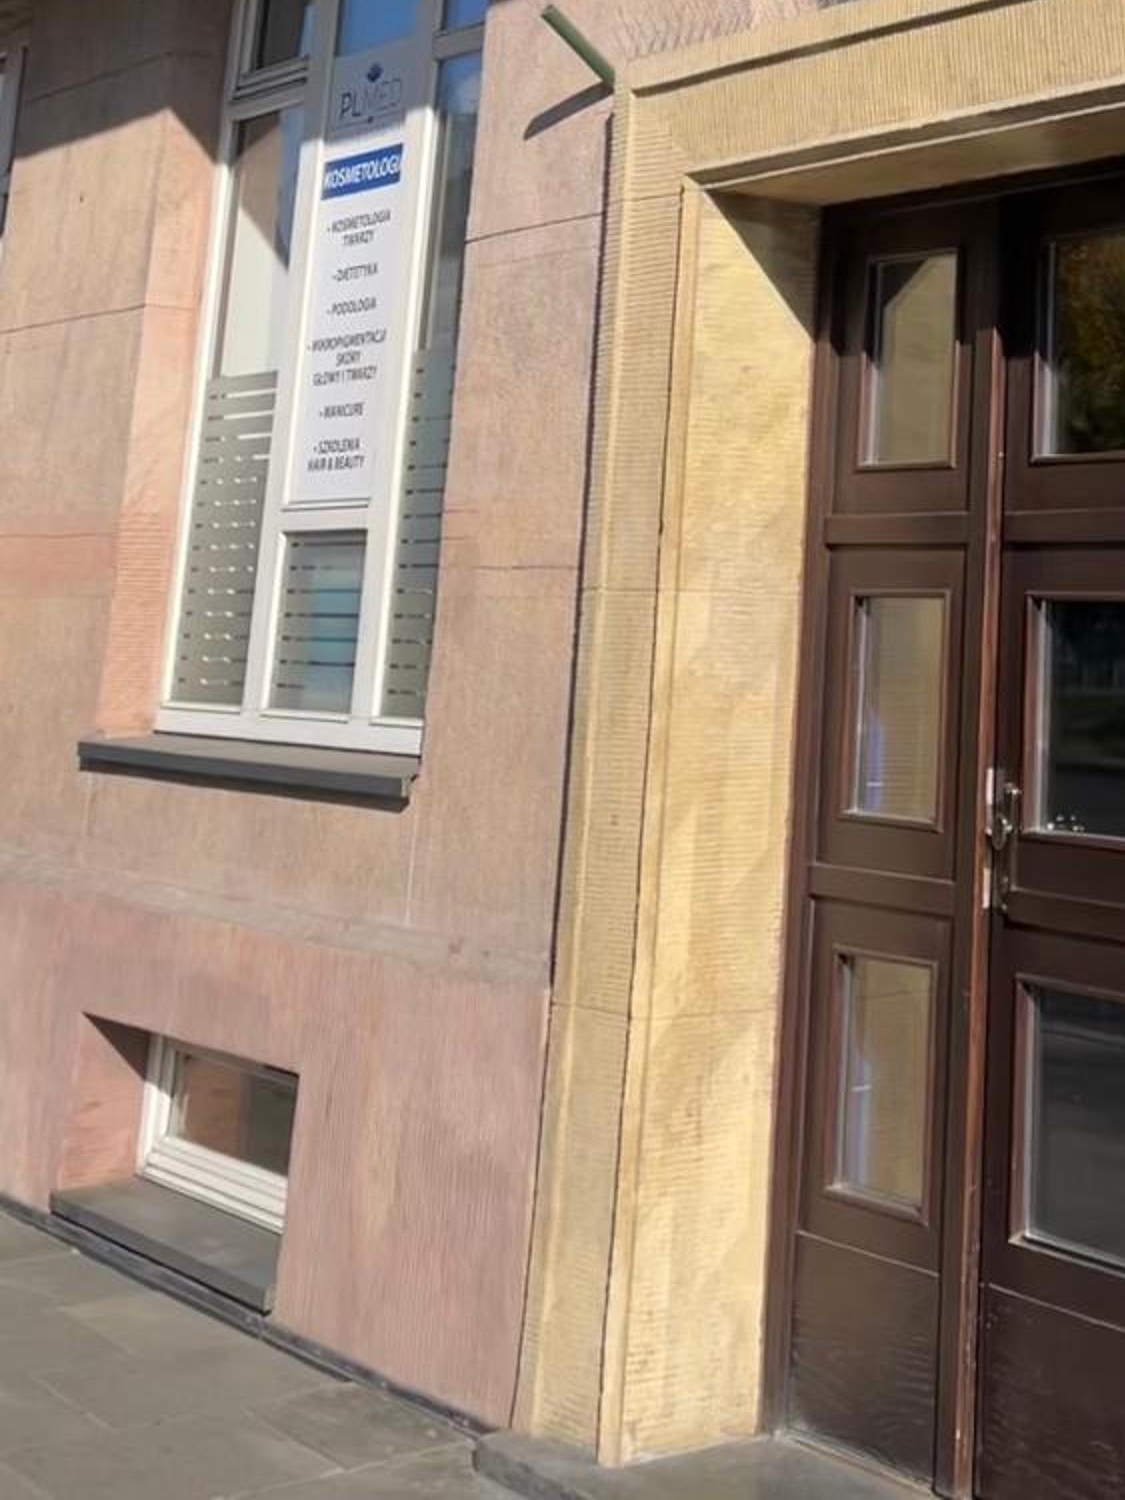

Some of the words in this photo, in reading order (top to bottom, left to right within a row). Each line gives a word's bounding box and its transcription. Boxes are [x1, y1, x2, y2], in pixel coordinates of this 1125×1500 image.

[331, 209, 391, 232] KOSMETOLOGIA
[332, 297, 376, 315] PODOLOGIA
[324, 402, 364, 418] MANICURE
[319, 438, 360, 454] SZKOLENIA
